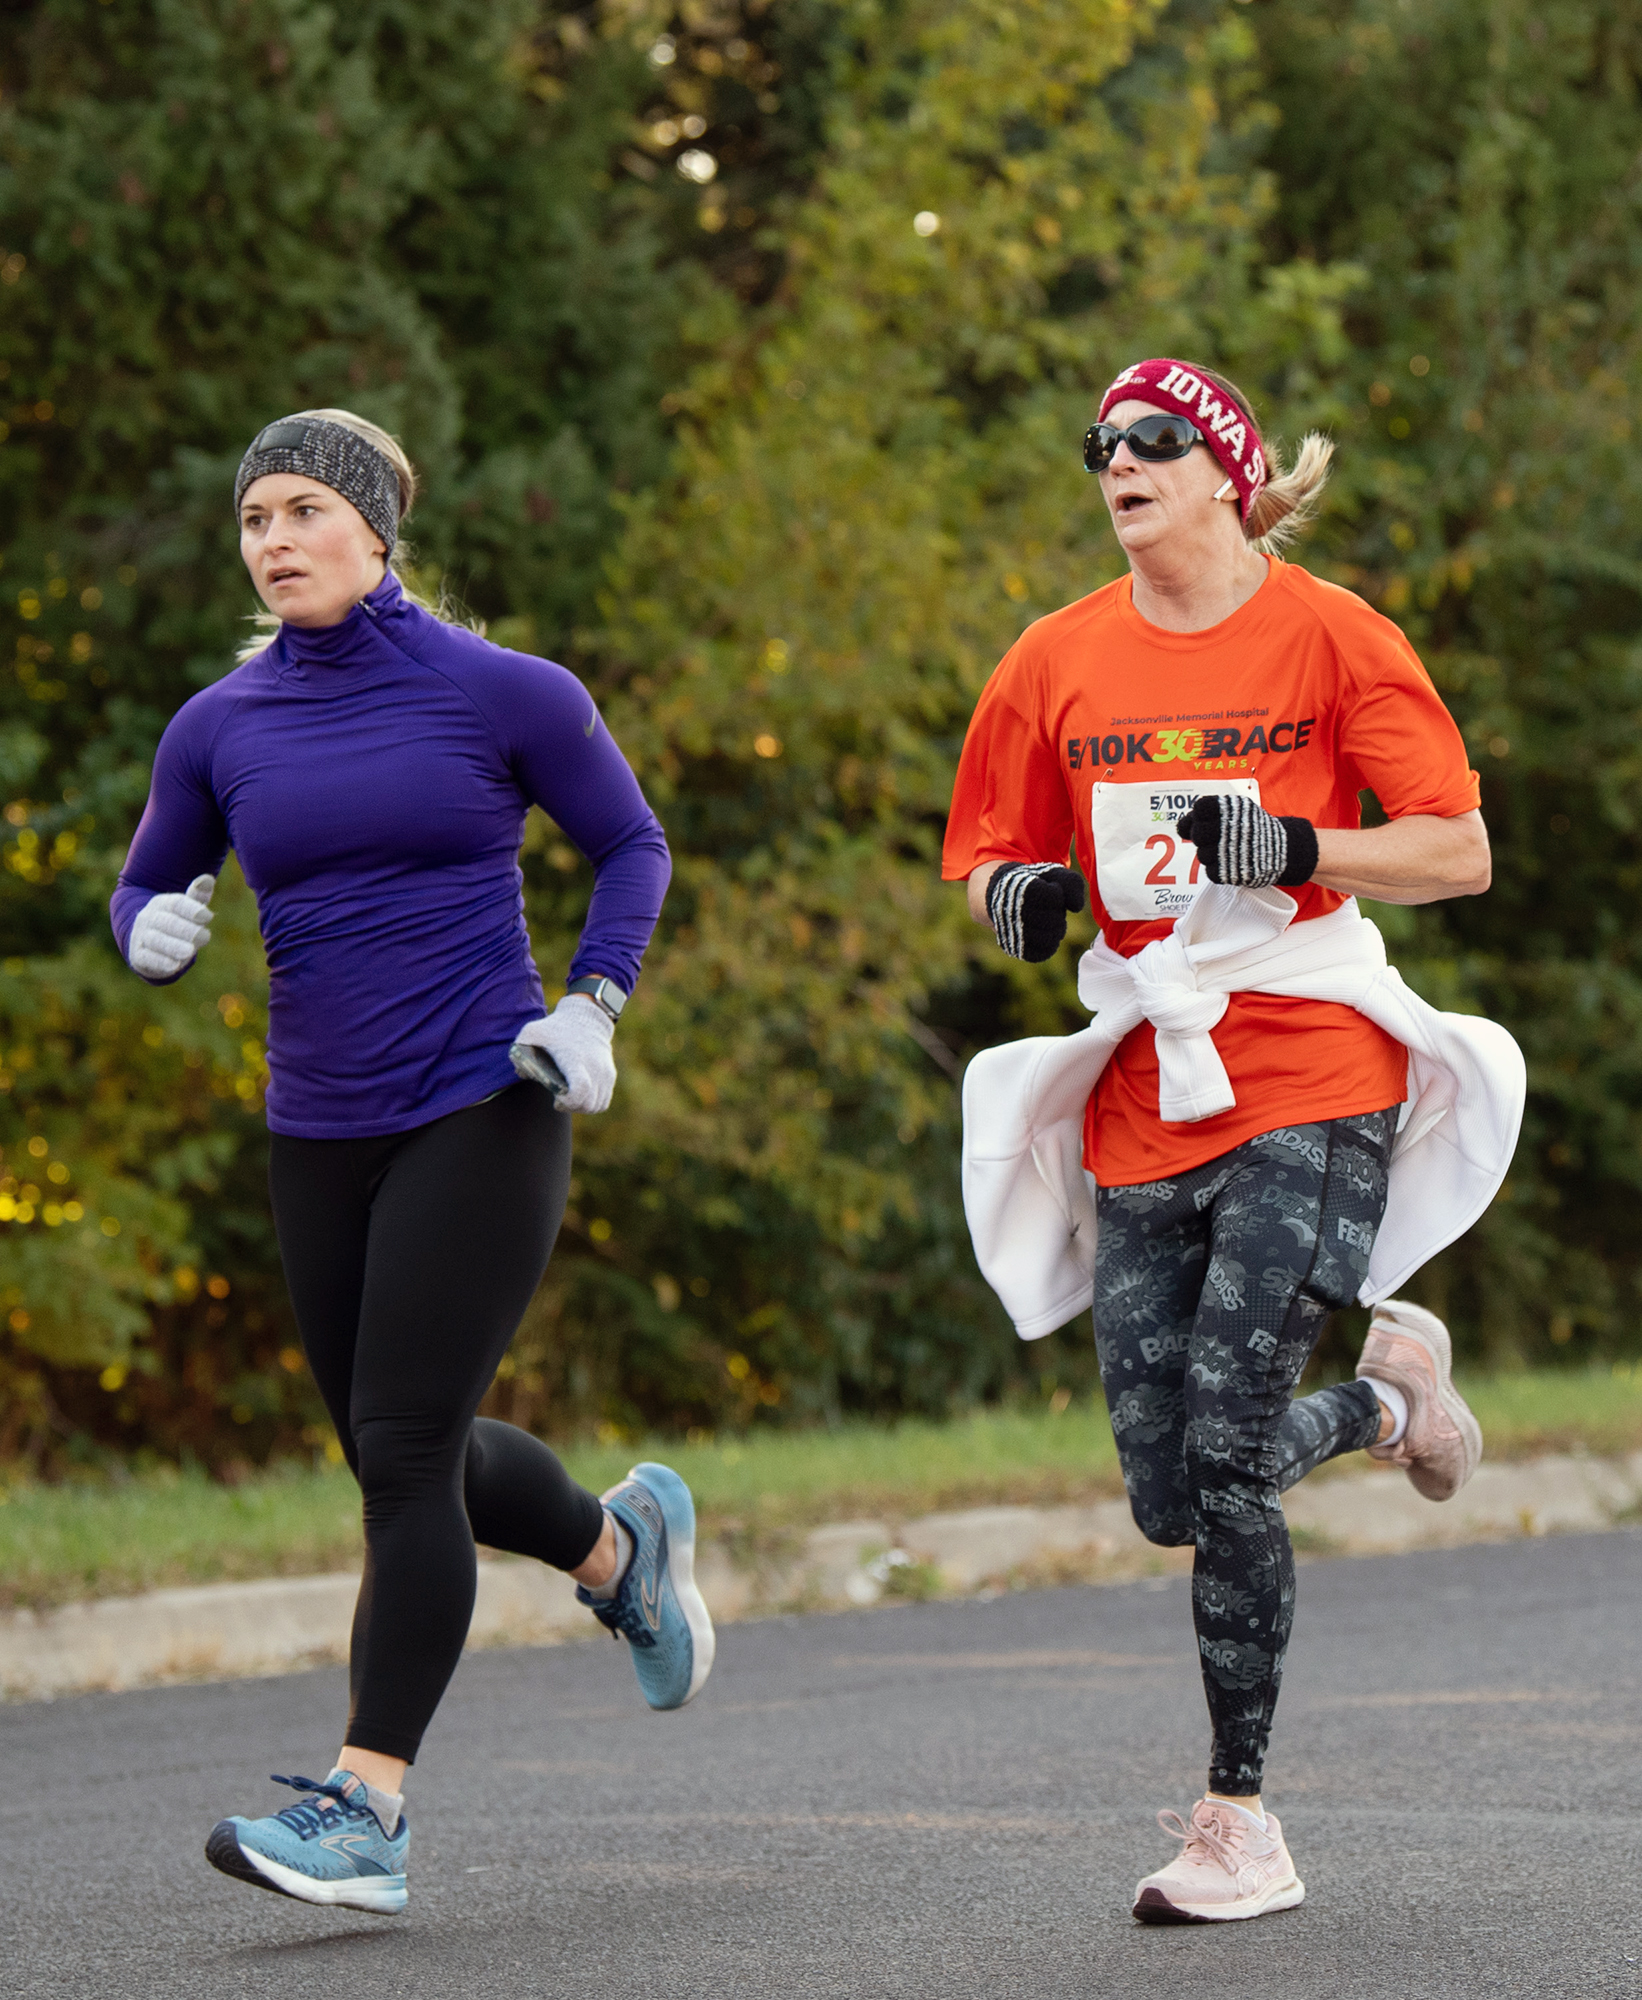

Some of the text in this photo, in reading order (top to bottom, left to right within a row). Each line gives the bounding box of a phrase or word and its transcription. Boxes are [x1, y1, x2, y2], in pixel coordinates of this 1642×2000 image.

[1156, 365, 1247, 463] IOWA
[1110, 706, 1270, 727] Jacksonville Memorial Hospital
[1202, 718, 1316, 759] RACE
[1193, 758, 1249, 771] YEARS
[1166, 811, 1187, 821] RA
[1154, 888, 1195, 905] Brow
